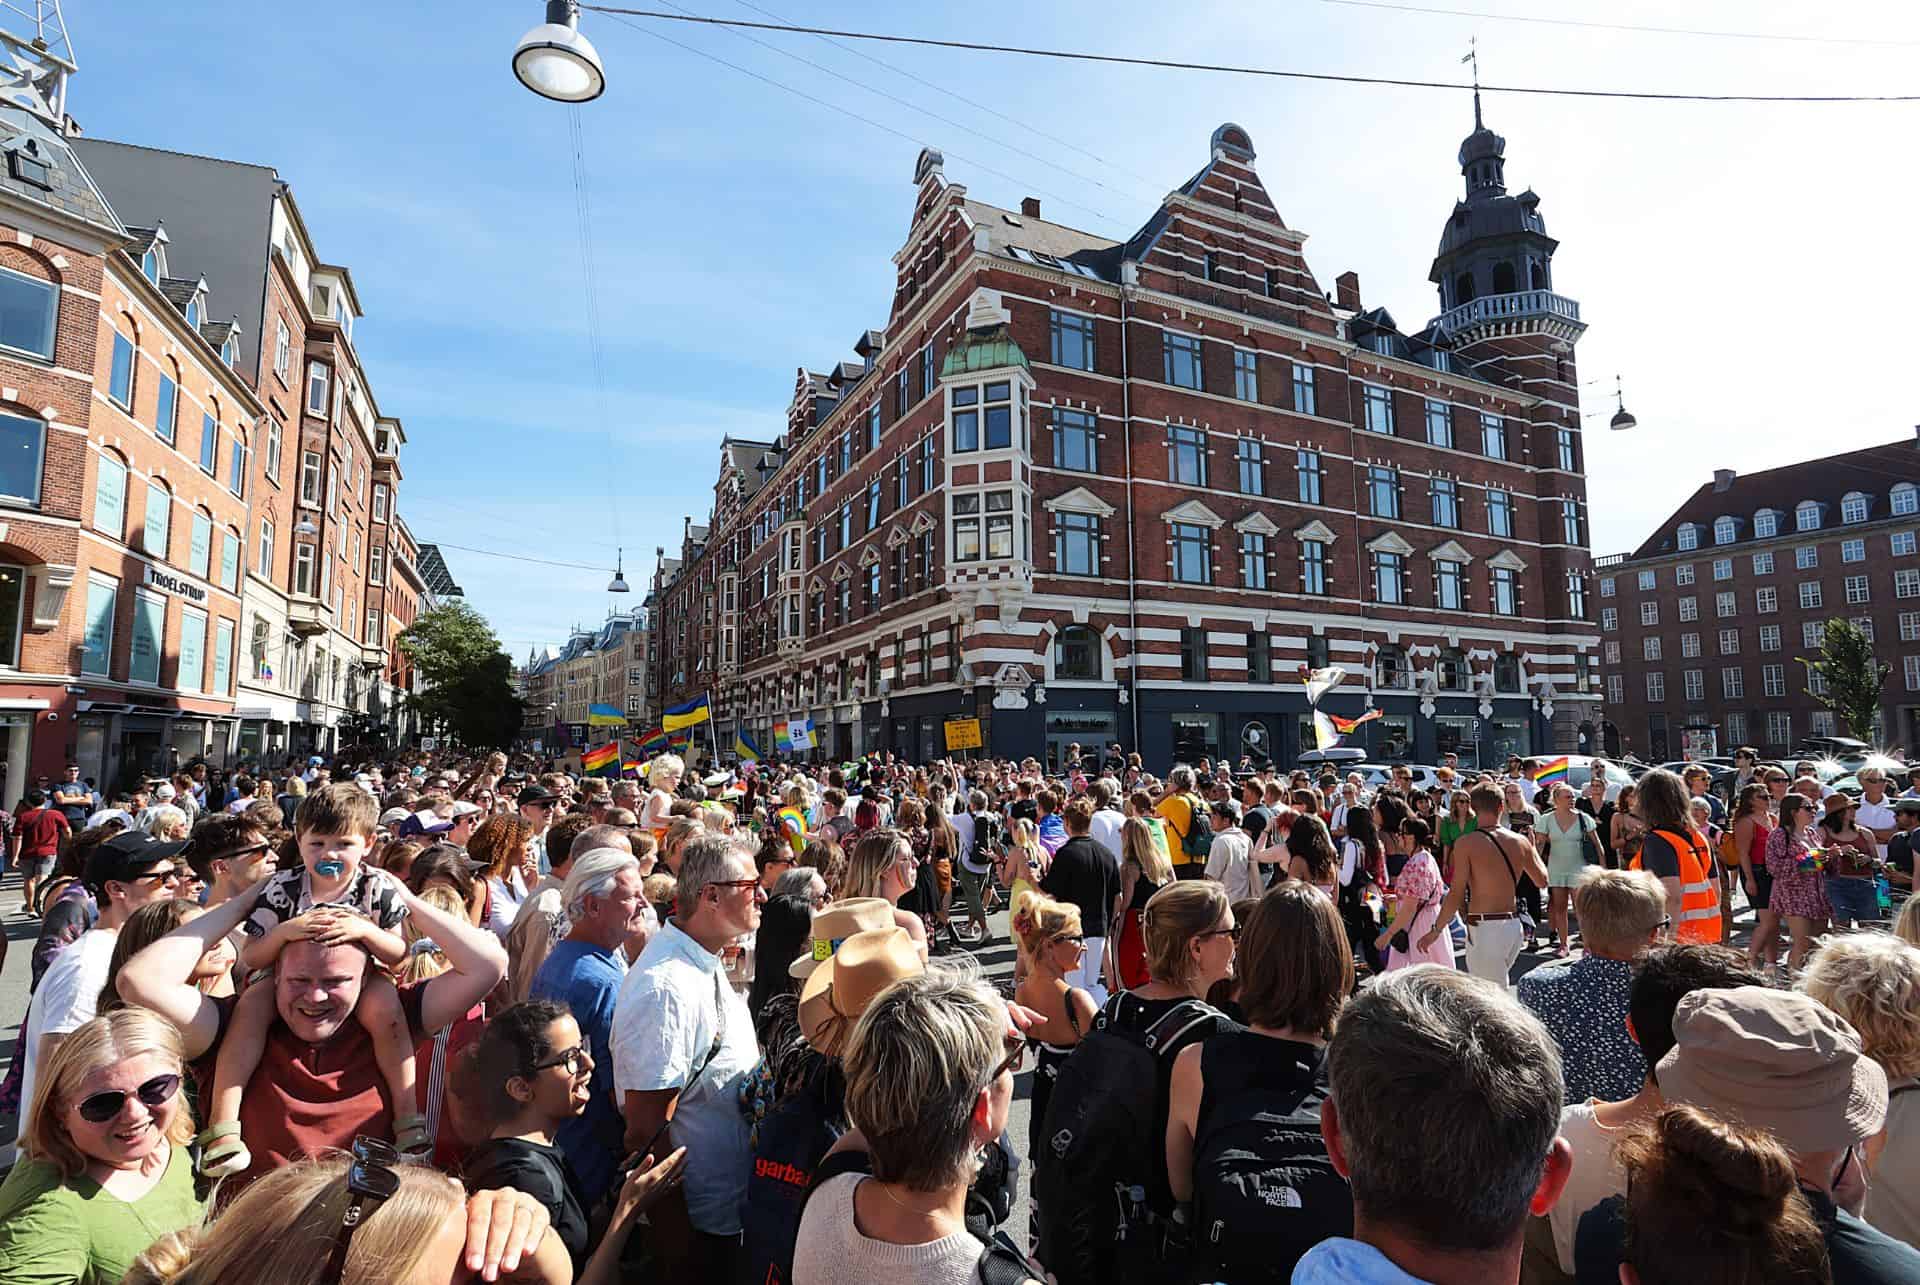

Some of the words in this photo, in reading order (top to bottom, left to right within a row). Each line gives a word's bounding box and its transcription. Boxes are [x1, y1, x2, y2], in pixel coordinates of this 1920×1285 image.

[151, 570, 206, 601] TROELSTRUP
[755, 1157, 812, 1187] garba
[1270, 1185, 1287, 1193] THE
[1258, 1190, 1287, 1200] NORTH
[1265, 1199, 1287, 1207] FACE
